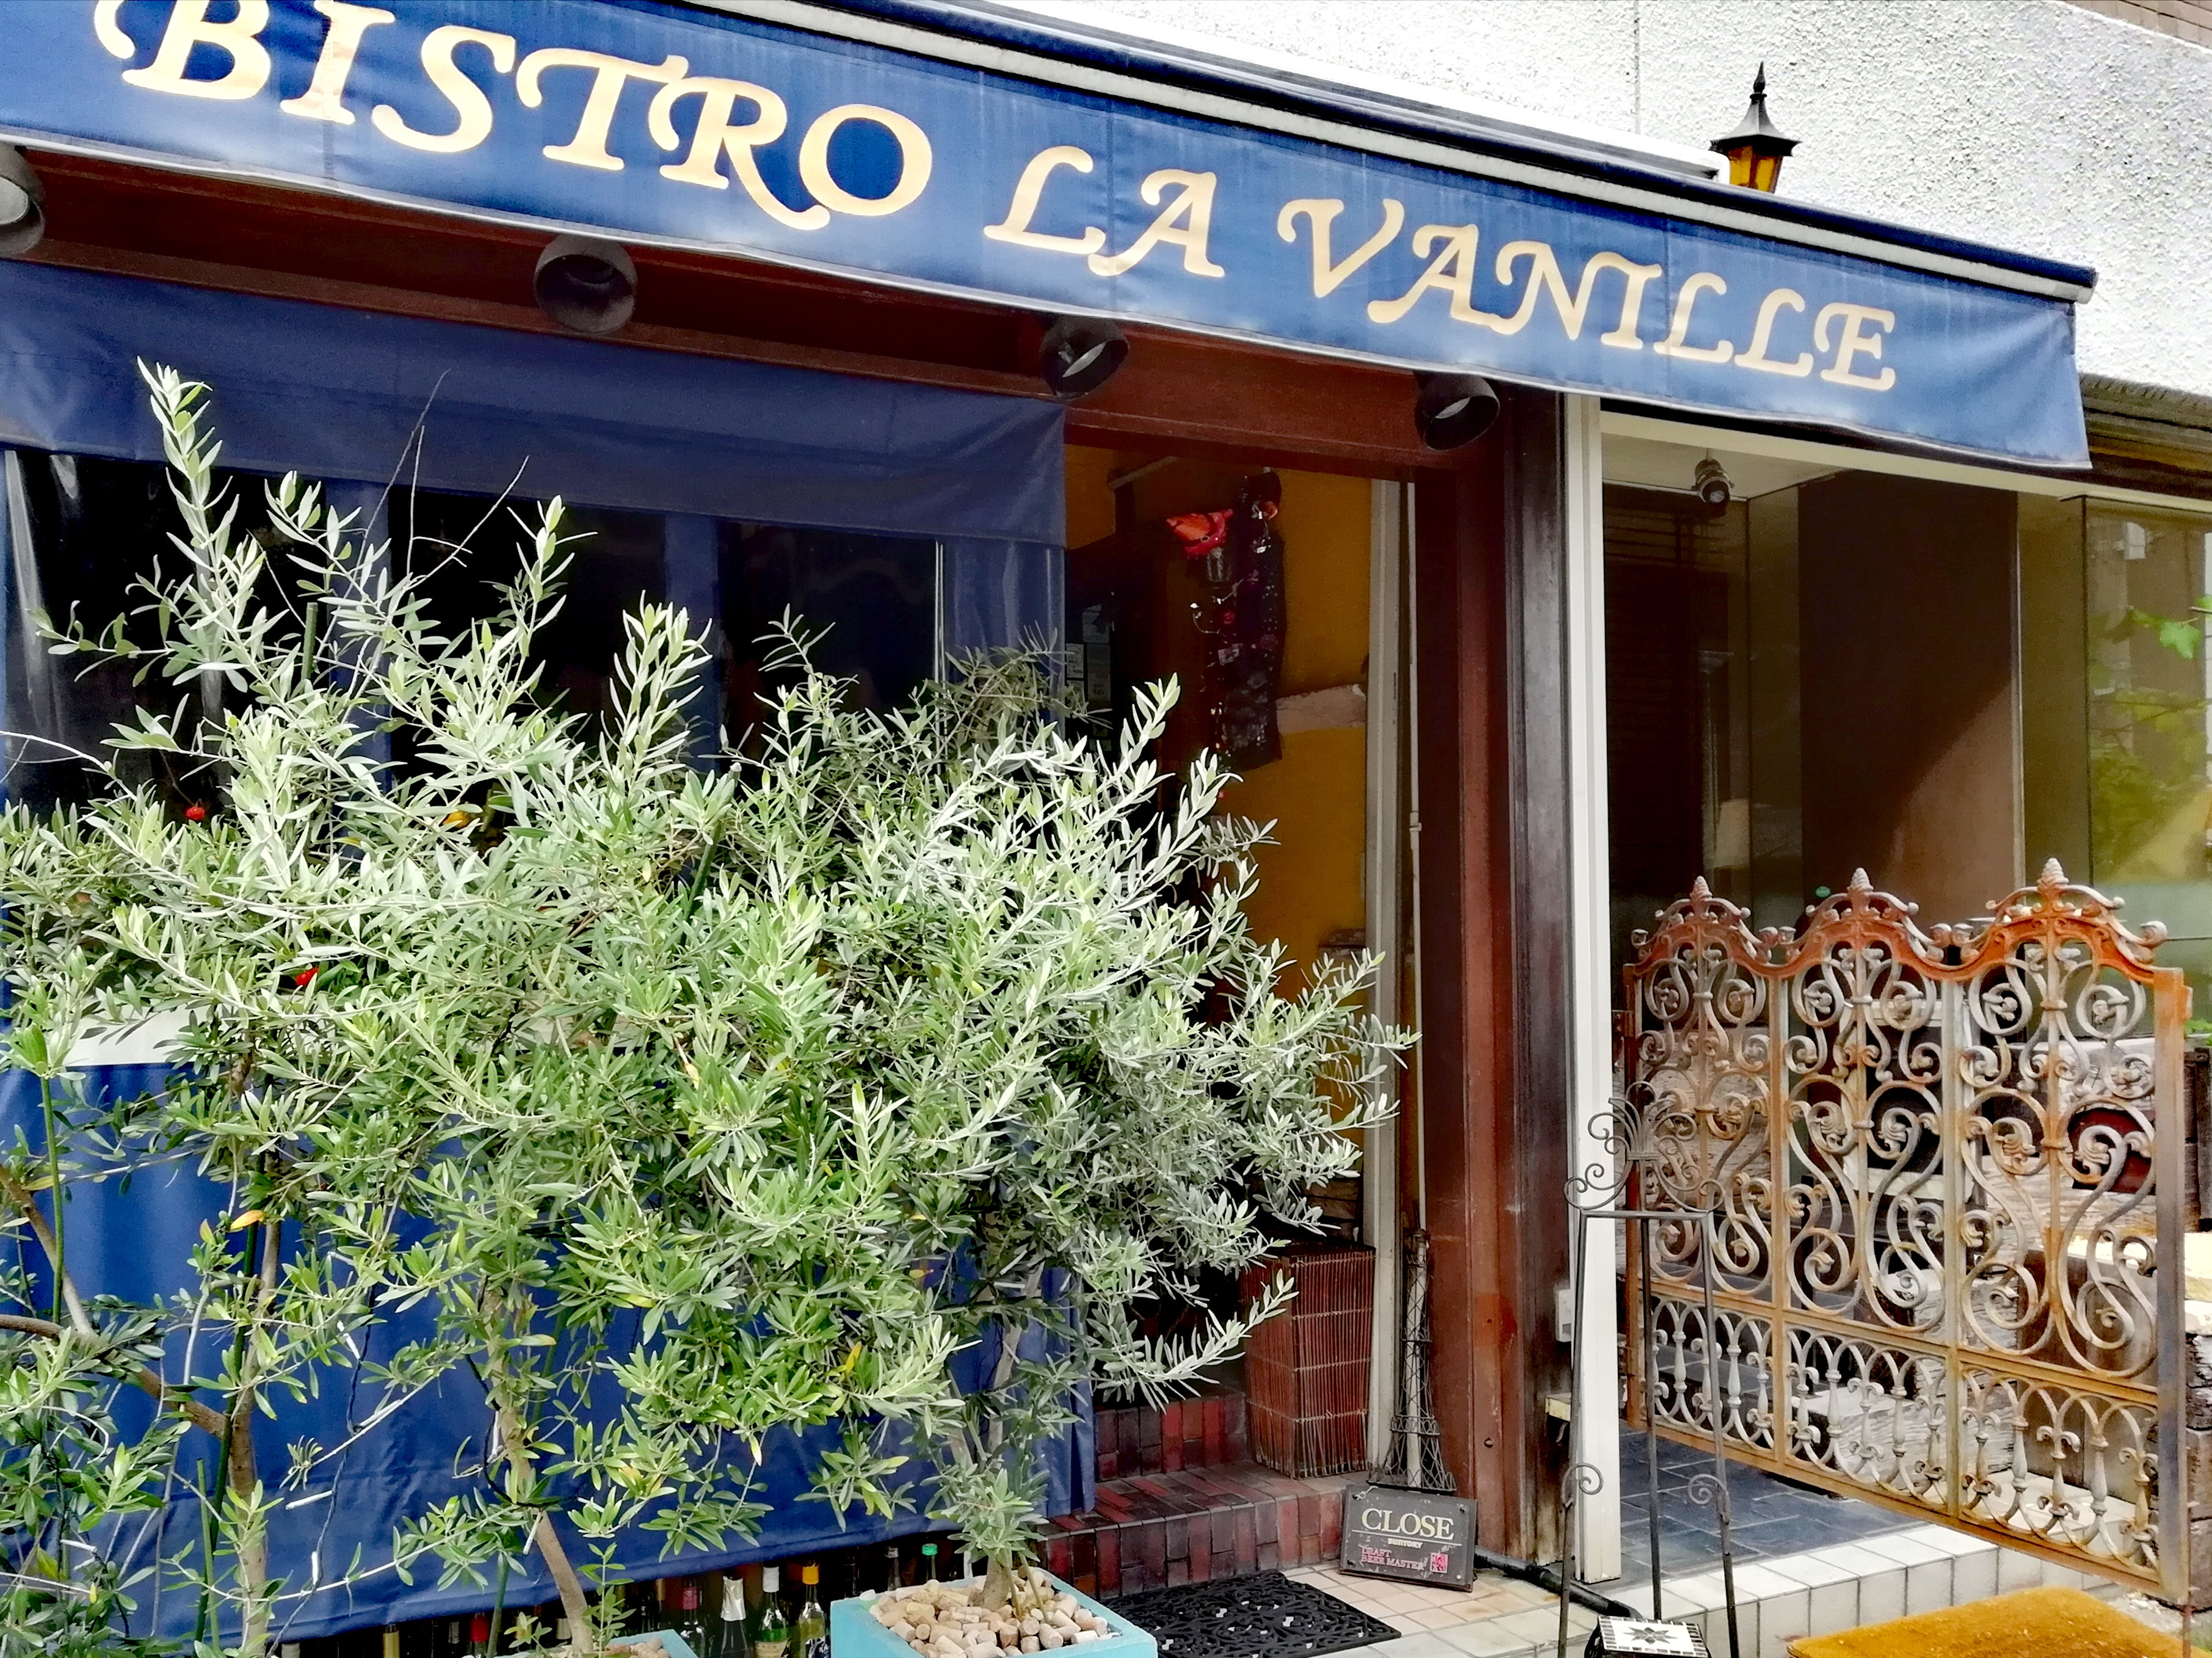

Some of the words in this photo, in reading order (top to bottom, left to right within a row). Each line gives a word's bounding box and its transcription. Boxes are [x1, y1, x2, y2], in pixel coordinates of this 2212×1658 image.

[95, 0, 932, 230] BISTRO
[984, 145, 1226, 278] LA
[1277, 198, 1896, 392] VANILLE
[1362, 1508, 1454, 1540] CLOSE
[1360, 1554, 1385, 1565] BEER
[1386, 1557, 1425, 1571] MASTER
[1361, 1546, 1392, 1558] DRAFT
